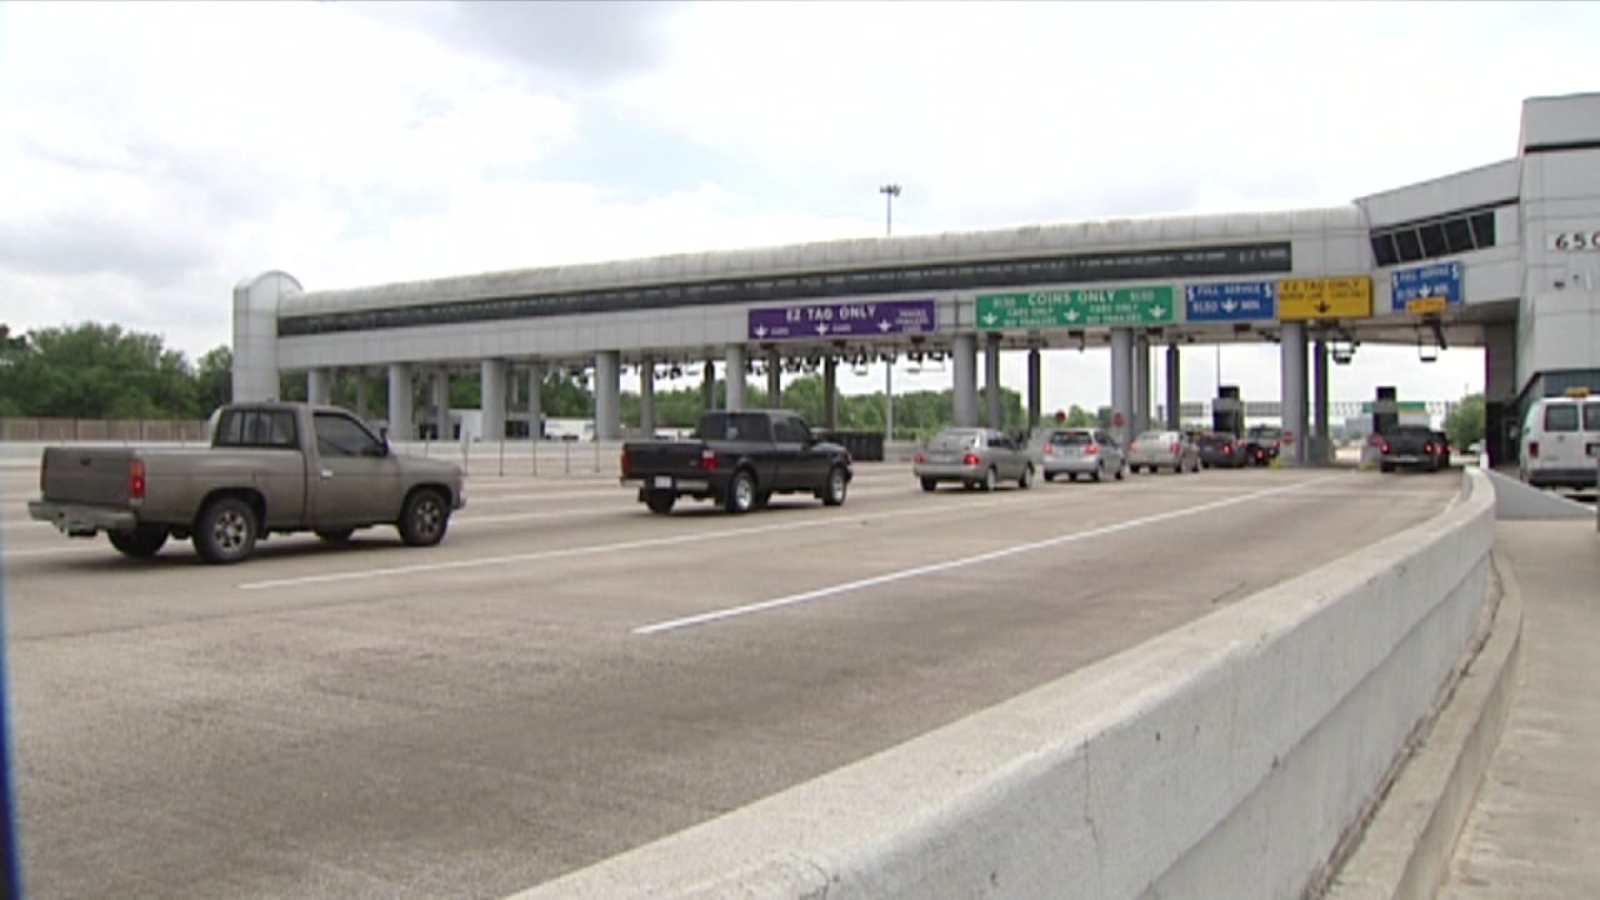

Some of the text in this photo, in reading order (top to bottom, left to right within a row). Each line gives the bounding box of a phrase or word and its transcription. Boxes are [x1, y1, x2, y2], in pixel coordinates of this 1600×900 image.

[1225, 283, 1261, 295] SERVICE
[1303, 279, 1325, 291] TAG
[1328, 279, 1361, 290] ONLY
[1028, 289, 1117, 306] COINS ONLY
[786, 304, 877, 322] EZ TAG ONLY
